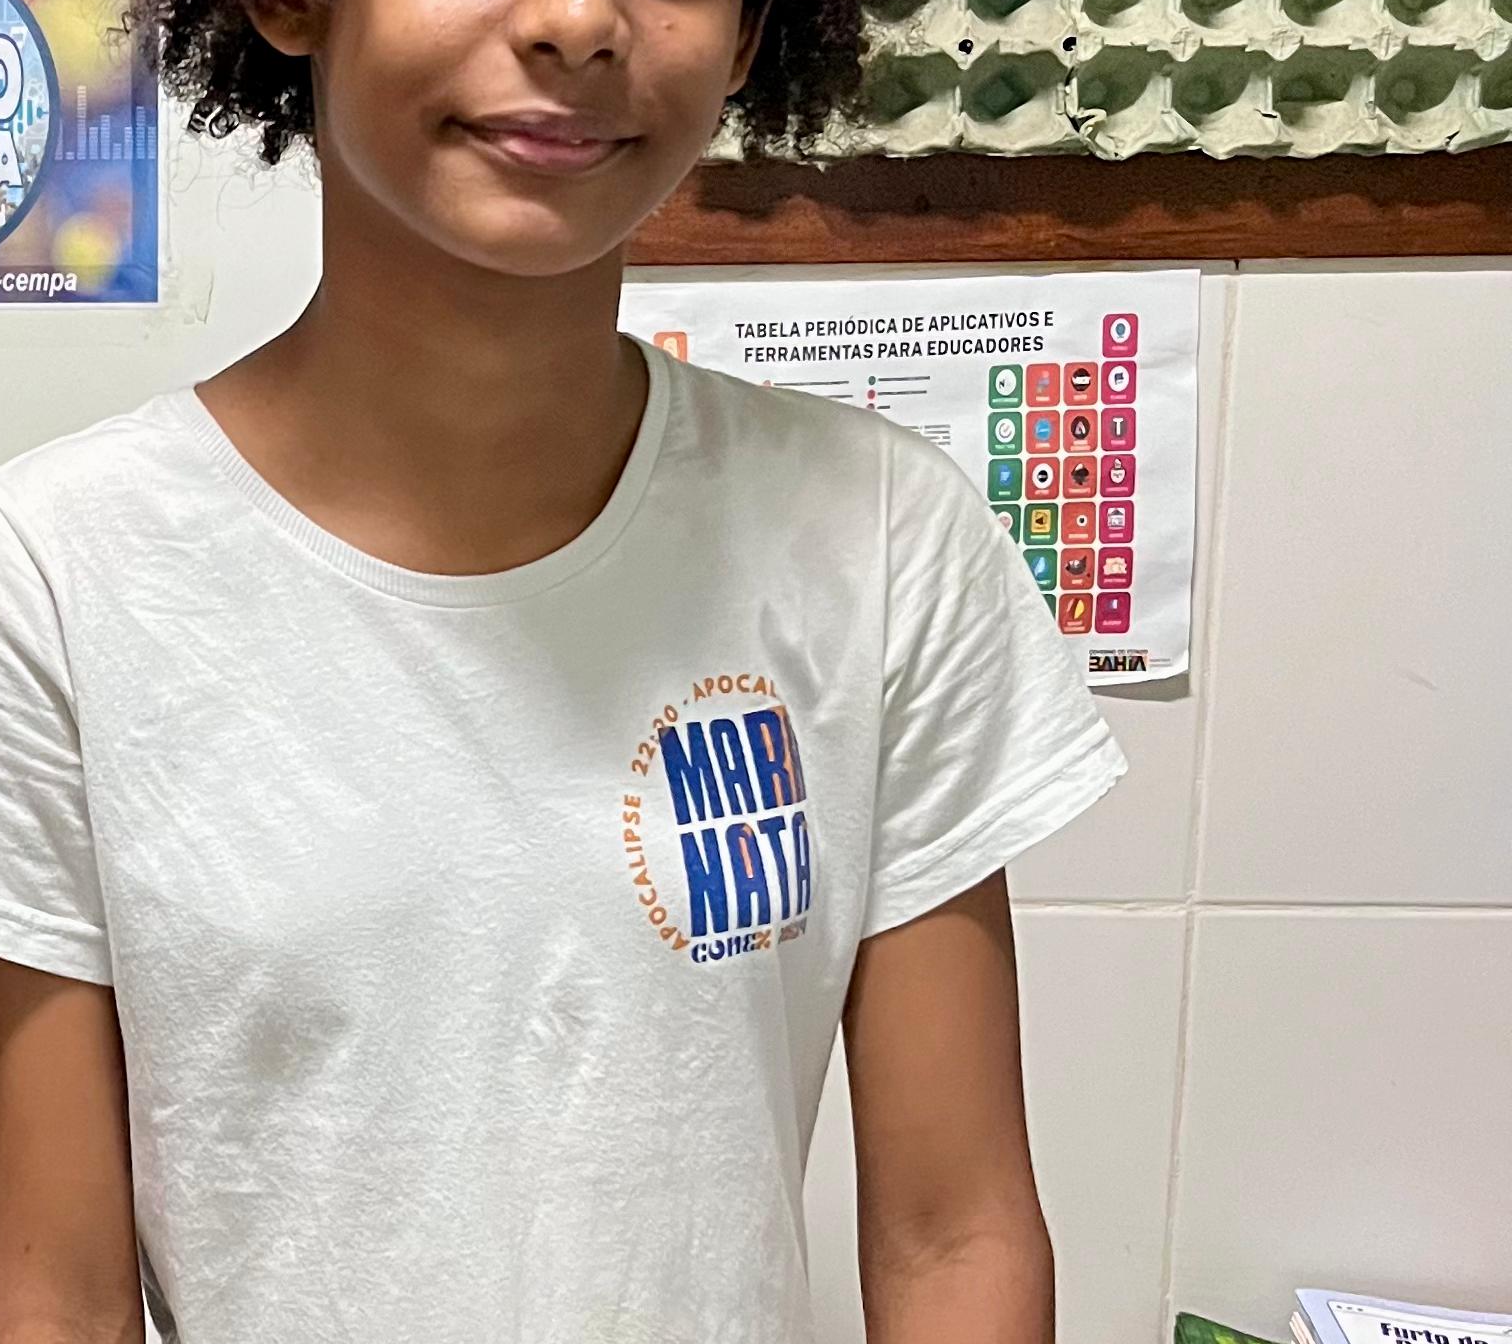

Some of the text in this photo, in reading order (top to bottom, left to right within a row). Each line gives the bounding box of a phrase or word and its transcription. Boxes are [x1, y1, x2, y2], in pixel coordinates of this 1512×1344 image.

[735, 311, 1054, 339] TABELA PERIÓDICA DE APLICATIVOS E
[744, 336, 1044, 363] FERRAMENTAS PARA EDUCADORES
[622, 793, 690, 951] APOCALIPSE
[680, 810, 811, 938] NATA
